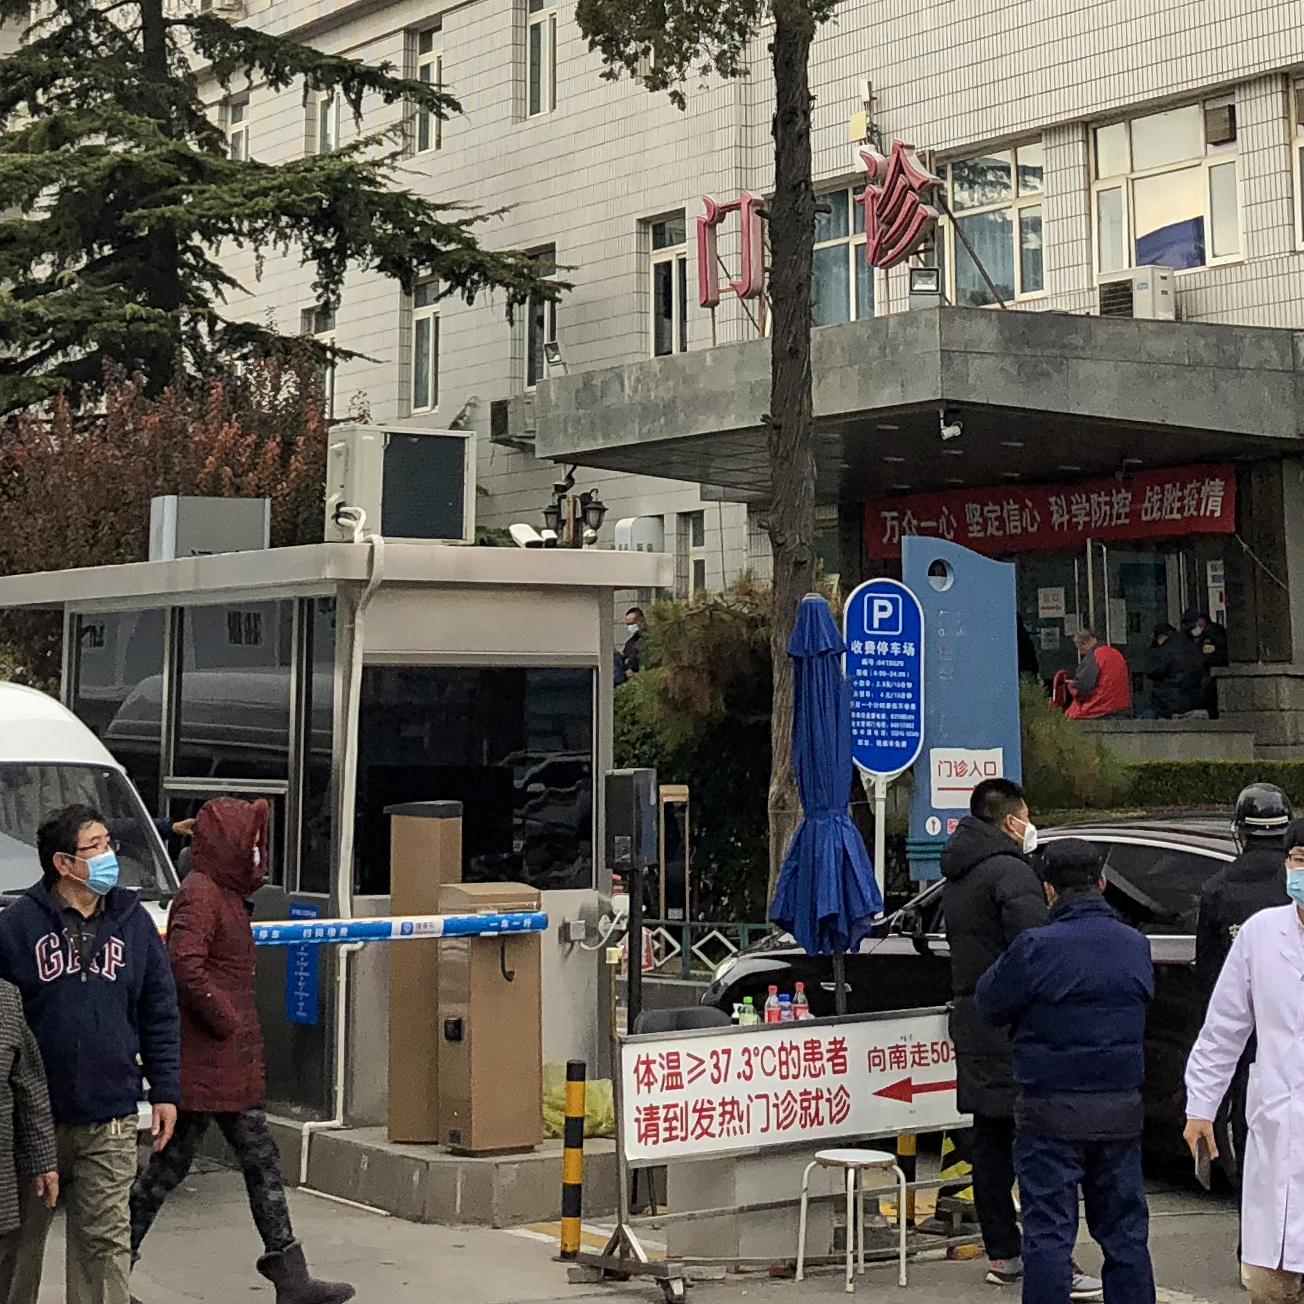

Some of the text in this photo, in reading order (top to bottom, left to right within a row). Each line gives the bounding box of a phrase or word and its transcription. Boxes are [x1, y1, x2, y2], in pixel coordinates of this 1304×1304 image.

[696, 138, 944, 308] 门诊
[880, 478, 1225, 544] 万众一心 坚定信心 科学防控 战胜疫情
[872, 599, 894, 629] P
[850, 640, 916, 657] 收费停车场
[937, 760, 997, 778] 门诊入口
[634, 1084, 851, 1146] 请到发热门诊就诊
